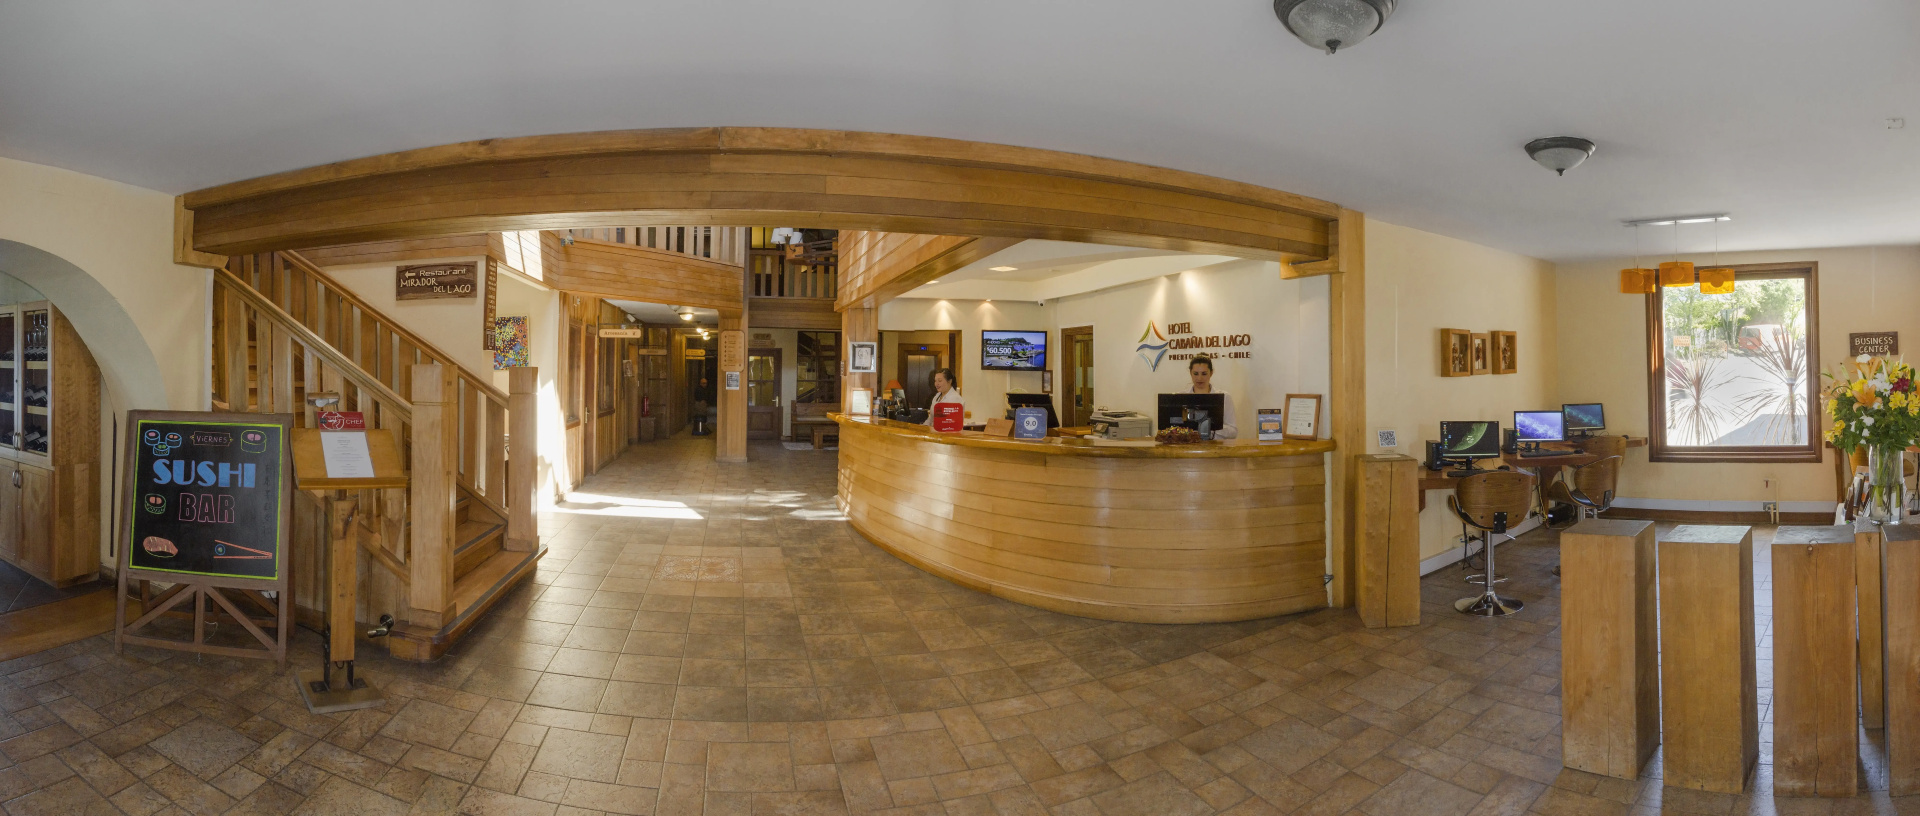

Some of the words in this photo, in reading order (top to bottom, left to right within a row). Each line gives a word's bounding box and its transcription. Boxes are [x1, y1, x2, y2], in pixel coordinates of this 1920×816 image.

[419, 267, 467, 277] Restaurant
[400, 278, 438, 288] MIRADOR
[433, 285, 446, 293] DEL
[447, 284, 471, 294] LAGO
[1168, 322, 1192, 335] HOTEL
[1168, 336, 1204, 350] CABAÑA
[1205, 336, 1221, 348] DEL
[1223, 334, 1251, 348] LAGO
[1855, 337, 1893, 345] BUSINESS
[1859, 345, 1889, 353] CENTER
[152, 458, 256, 488] SUSHI
[179, 492, 235, 523] BAR
